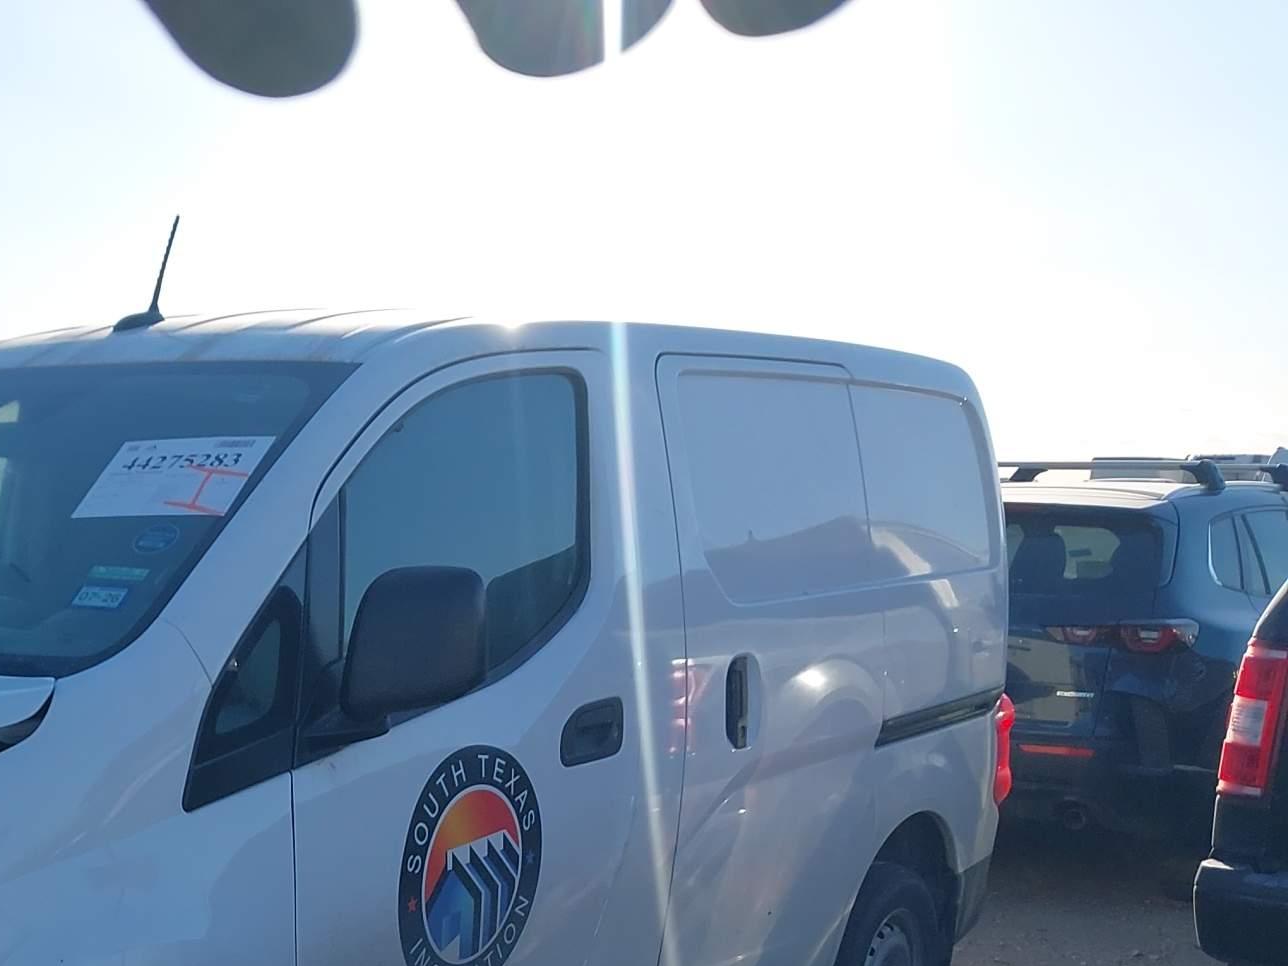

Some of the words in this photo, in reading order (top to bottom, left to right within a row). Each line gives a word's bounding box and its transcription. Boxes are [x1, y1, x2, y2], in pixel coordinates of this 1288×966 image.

[122, 452, 242, 471] 44275283
[407, 760, 467, 875] SOUTH
[477, 753, 535, 832] TEXAS
